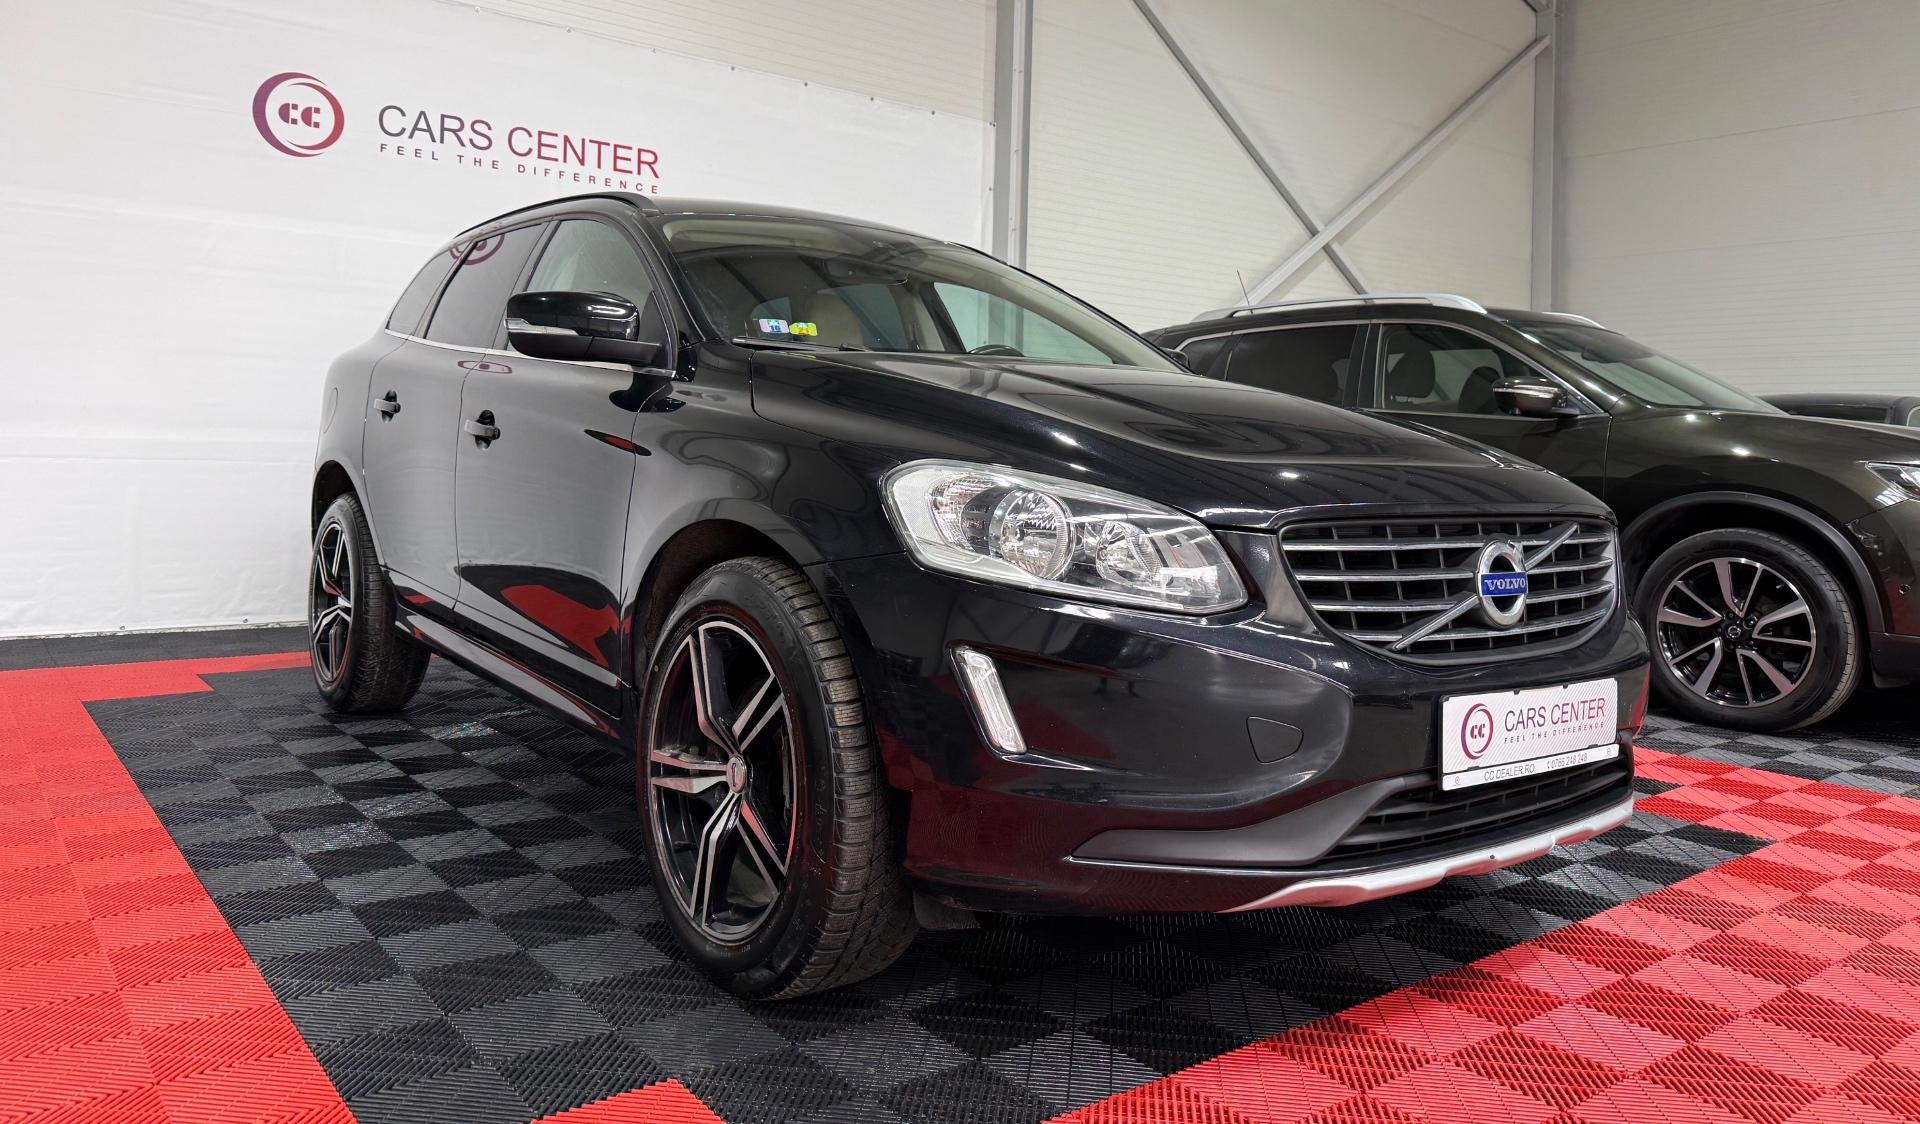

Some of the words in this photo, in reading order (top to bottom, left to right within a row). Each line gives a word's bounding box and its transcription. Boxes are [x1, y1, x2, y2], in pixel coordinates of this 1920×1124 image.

[379, 104, 493, 151] CARS
[507, 126, 660, 178] CENTER
[379, 143, 440, 162] FEEL
[456, 154, 500, 171] THE
[517, 164, 660, 194] DIFFERENCE
[1484, 577, 1526, 590] VOLVO
[1504, 706, 1547, 732] CARS
[1551, 697, 1606, 725] CENTER
[1504, 735, 1526, 744] FEEL
[1531, 730, 1547, 740] THE
[1552, 721, 1605, 737] DIFFERENCE
